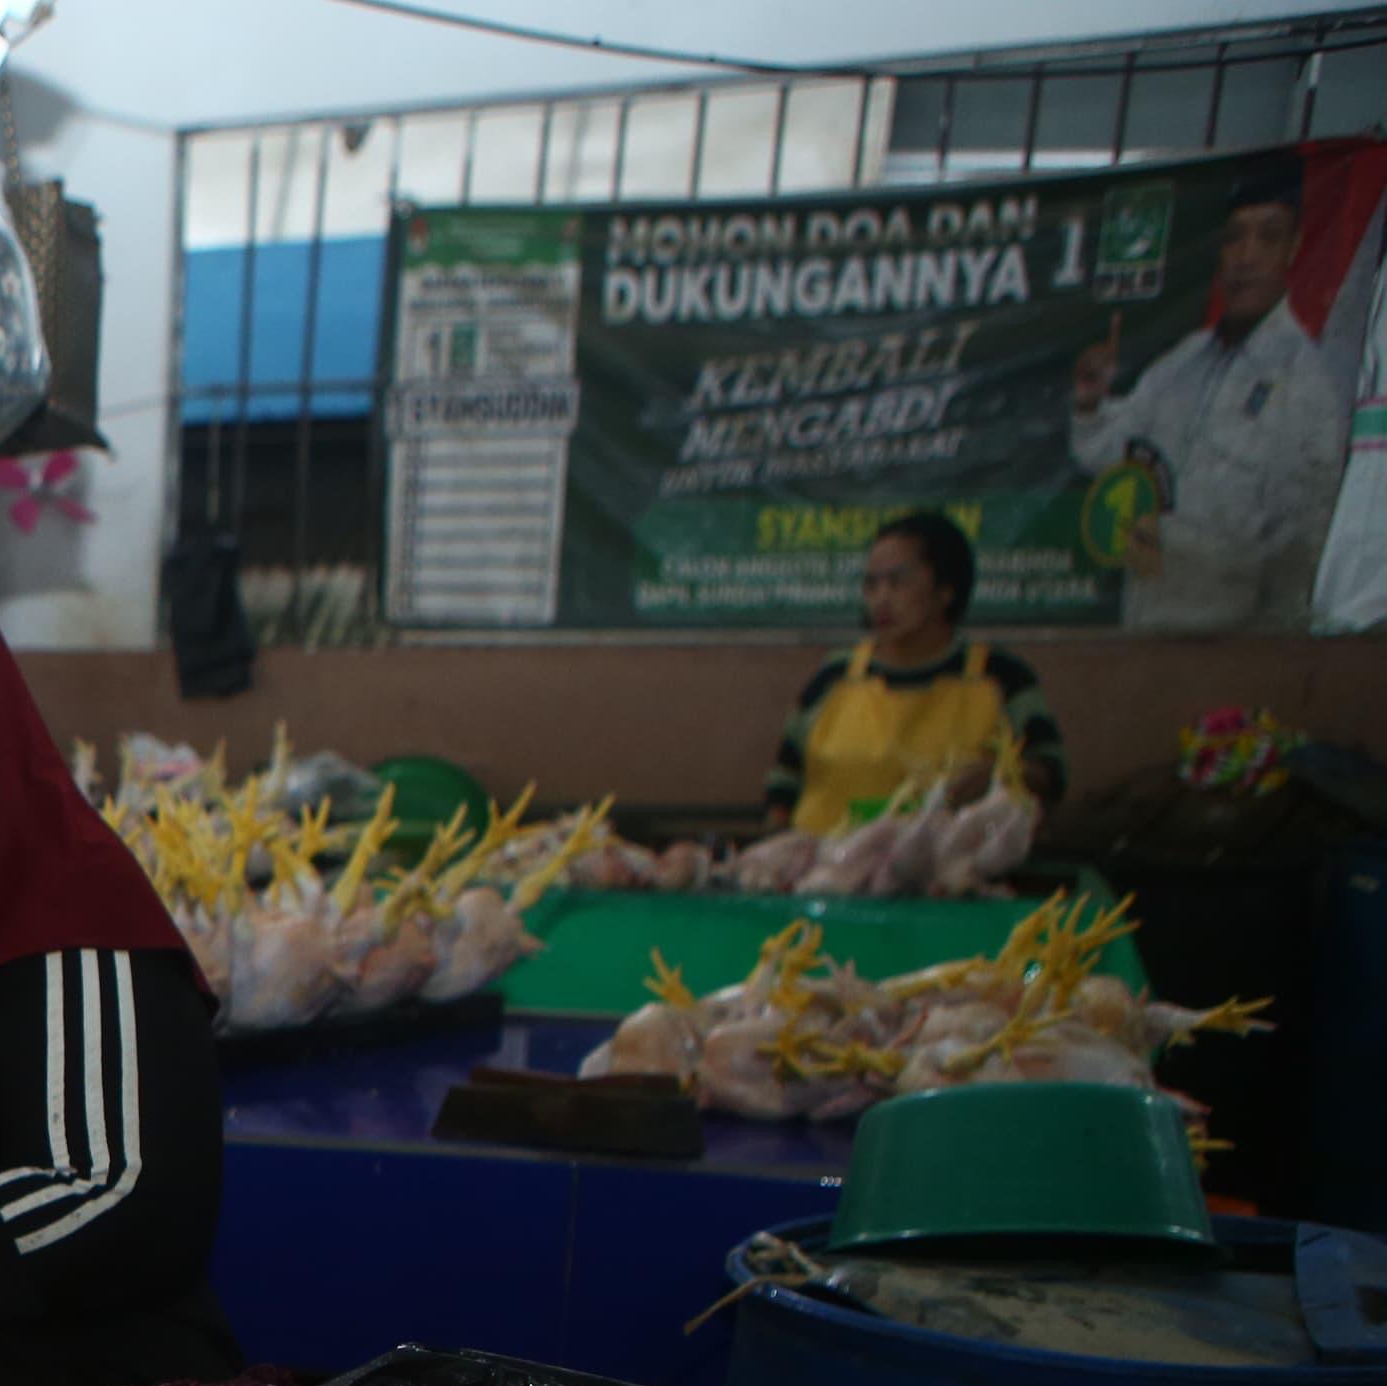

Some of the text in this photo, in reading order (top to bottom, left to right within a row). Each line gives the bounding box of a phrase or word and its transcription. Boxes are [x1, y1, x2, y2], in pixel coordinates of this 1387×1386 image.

[607, 196, 1038, 266] MOHON DOA DAN
[1053, 213, 1086, 288] 1
[602, 243, 1031, 322] DUKUNGANNYA
[684, 318, 980, 412] KEMBALI
[680, 379, 960, 463] MENGABDI
